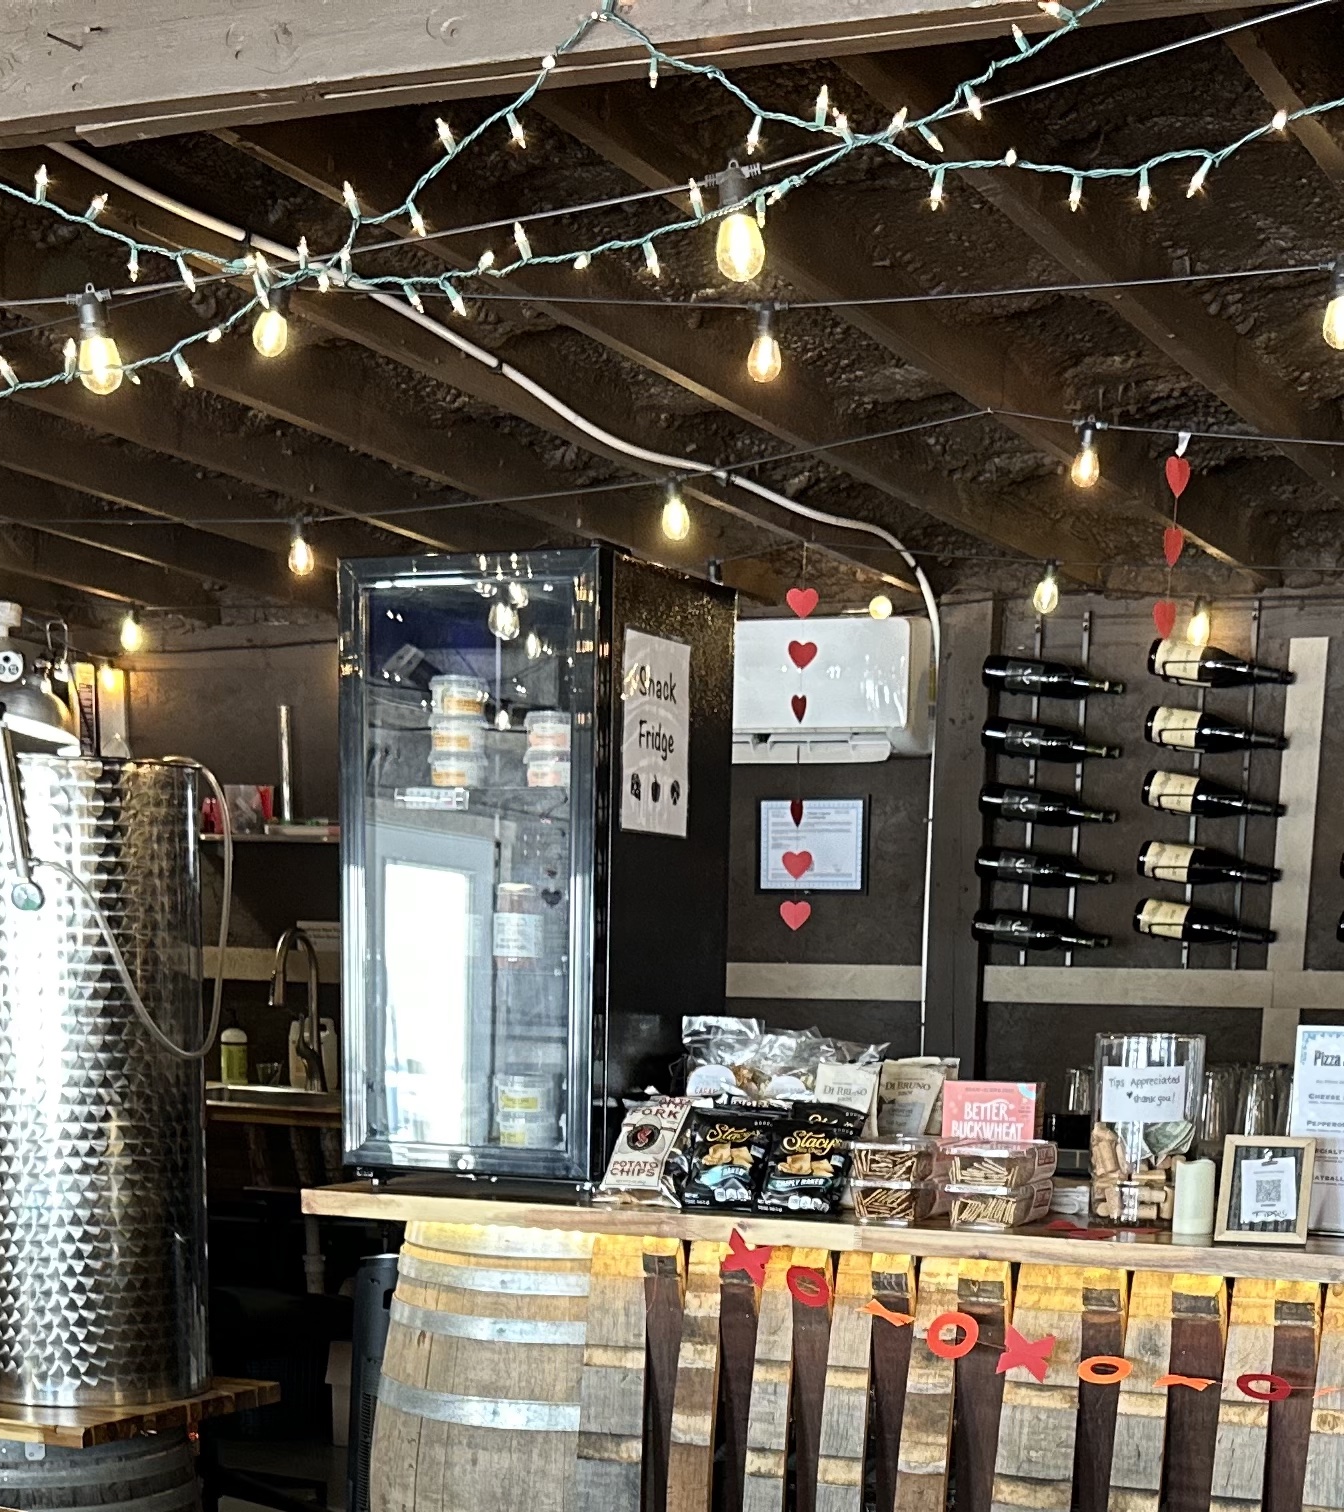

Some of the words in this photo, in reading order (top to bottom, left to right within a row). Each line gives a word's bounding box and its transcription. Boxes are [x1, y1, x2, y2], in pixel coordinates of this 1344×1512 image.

[639, 666, 676, 704] Snack
[638, 719, 674, 761] Fridge
[1314, 1050, 1341, 1067] Pizza
[1109, 1077, 1124, 1089] Tips
[1130, 1074, 1181, 1088] Appreciated
[964, 1099, 1009, 1121] BETTER
[950, 1120, 1025, 1141] BUCKWHEAT
[610, 1168, 656, 1177] CHIPS
[612, 1160, 659, 1169] POTATO
